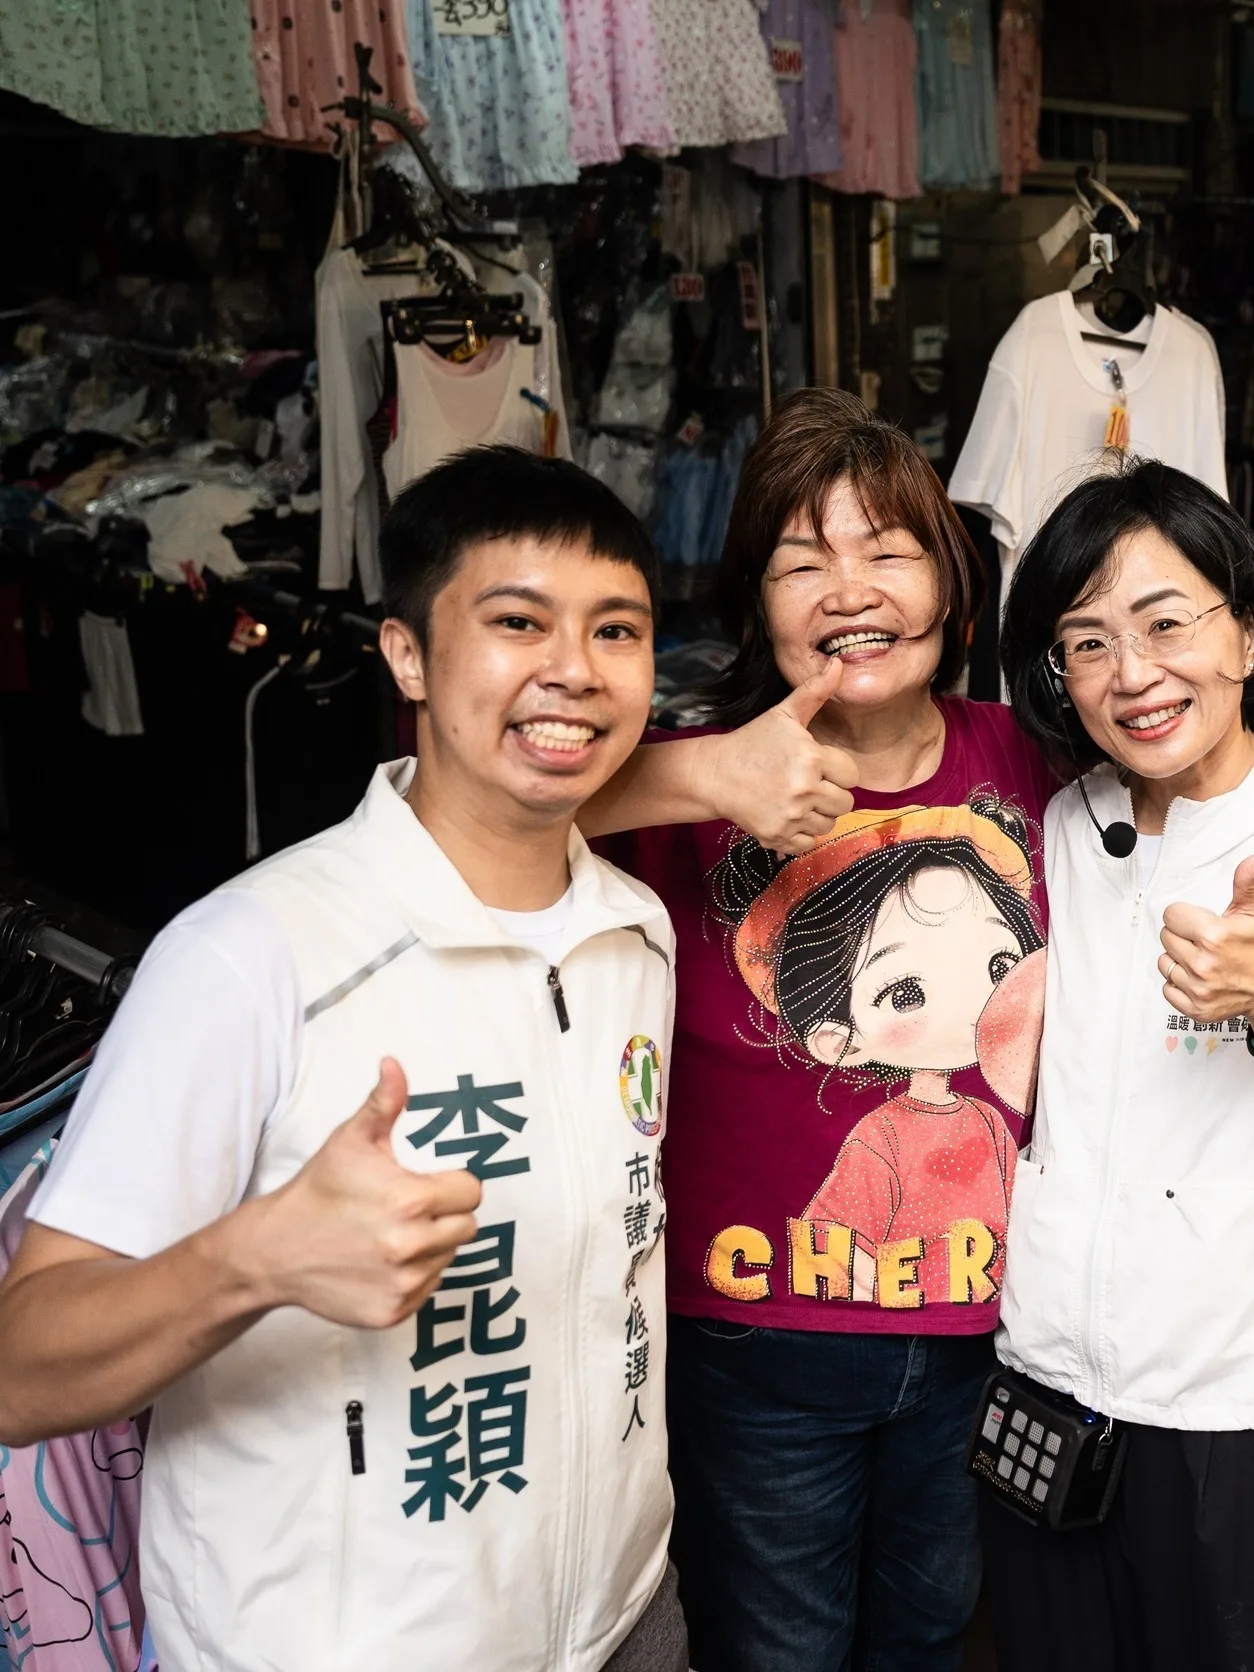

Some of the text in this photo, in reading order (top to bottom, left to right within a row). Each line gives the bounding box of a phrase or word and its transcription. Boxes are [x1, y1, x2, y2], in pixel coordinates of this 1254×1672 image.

[1167, 1014, 1190, 1031] 溫暖
[402, 1073, 532, 1523] 李昆穎
[622, 1151, 652, 1443] 市議員候選人
[704, 1216, 1000, 1310] CHER
